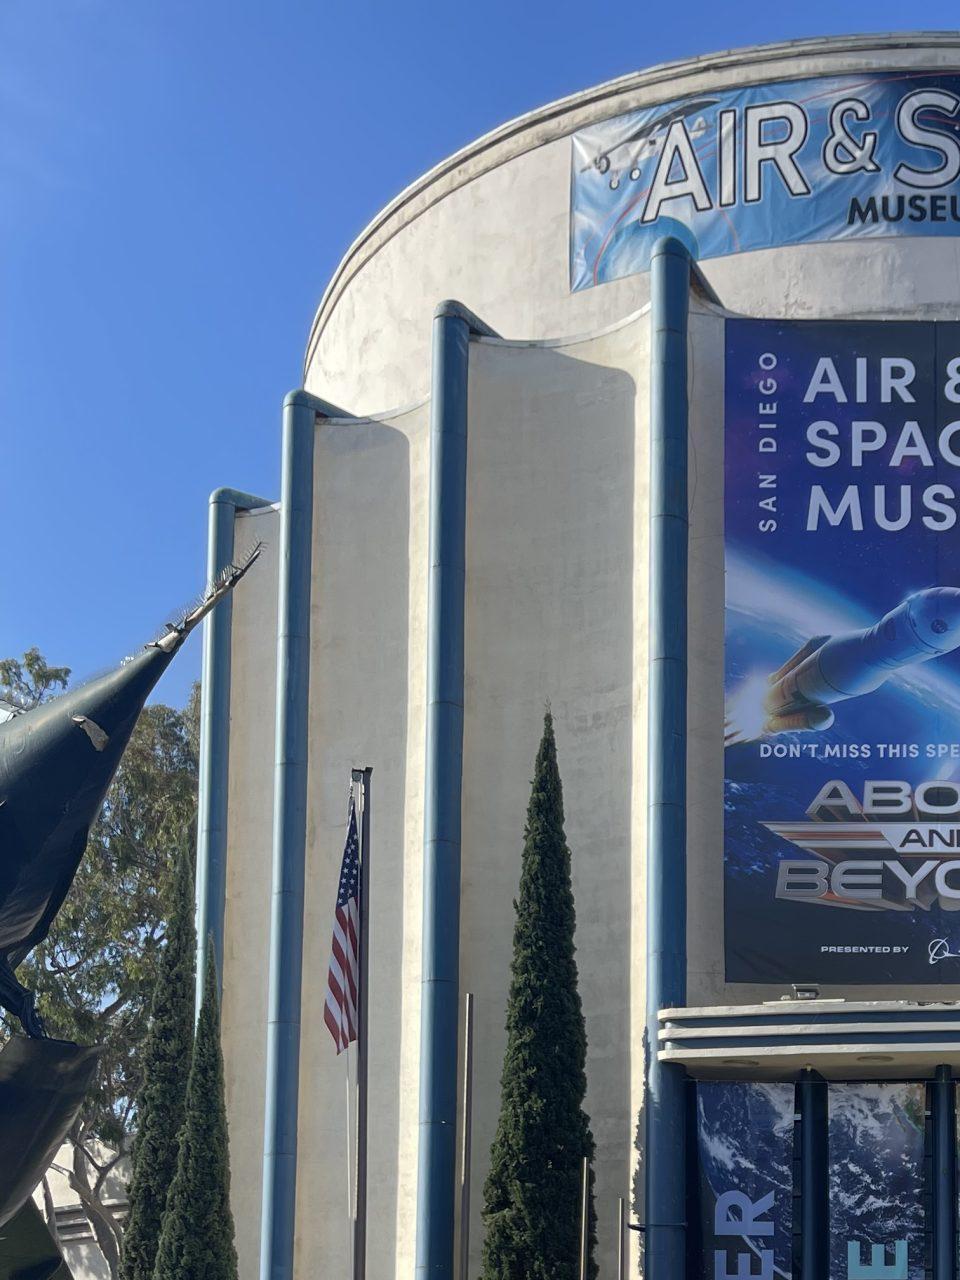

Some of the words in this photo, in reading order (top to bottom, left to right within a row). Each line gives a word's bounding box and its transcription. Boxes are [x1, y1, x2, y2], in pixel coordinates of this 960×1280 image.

[641, 101, 811, 225] AIR
[822, 98, 882, 175] &
[758, 352, 778, 453] DIEGO
[803, 356, 917, 403] AIR
[758, 473, 777, 533] SAN
[760, 743, 818, 758] DON'T
[825, 743, 871, 758] MISS
[877, 743, 919, 758] THIS
[820, 945, 890, 953] PRESENTED
[893, 945, 909, 953] BY
